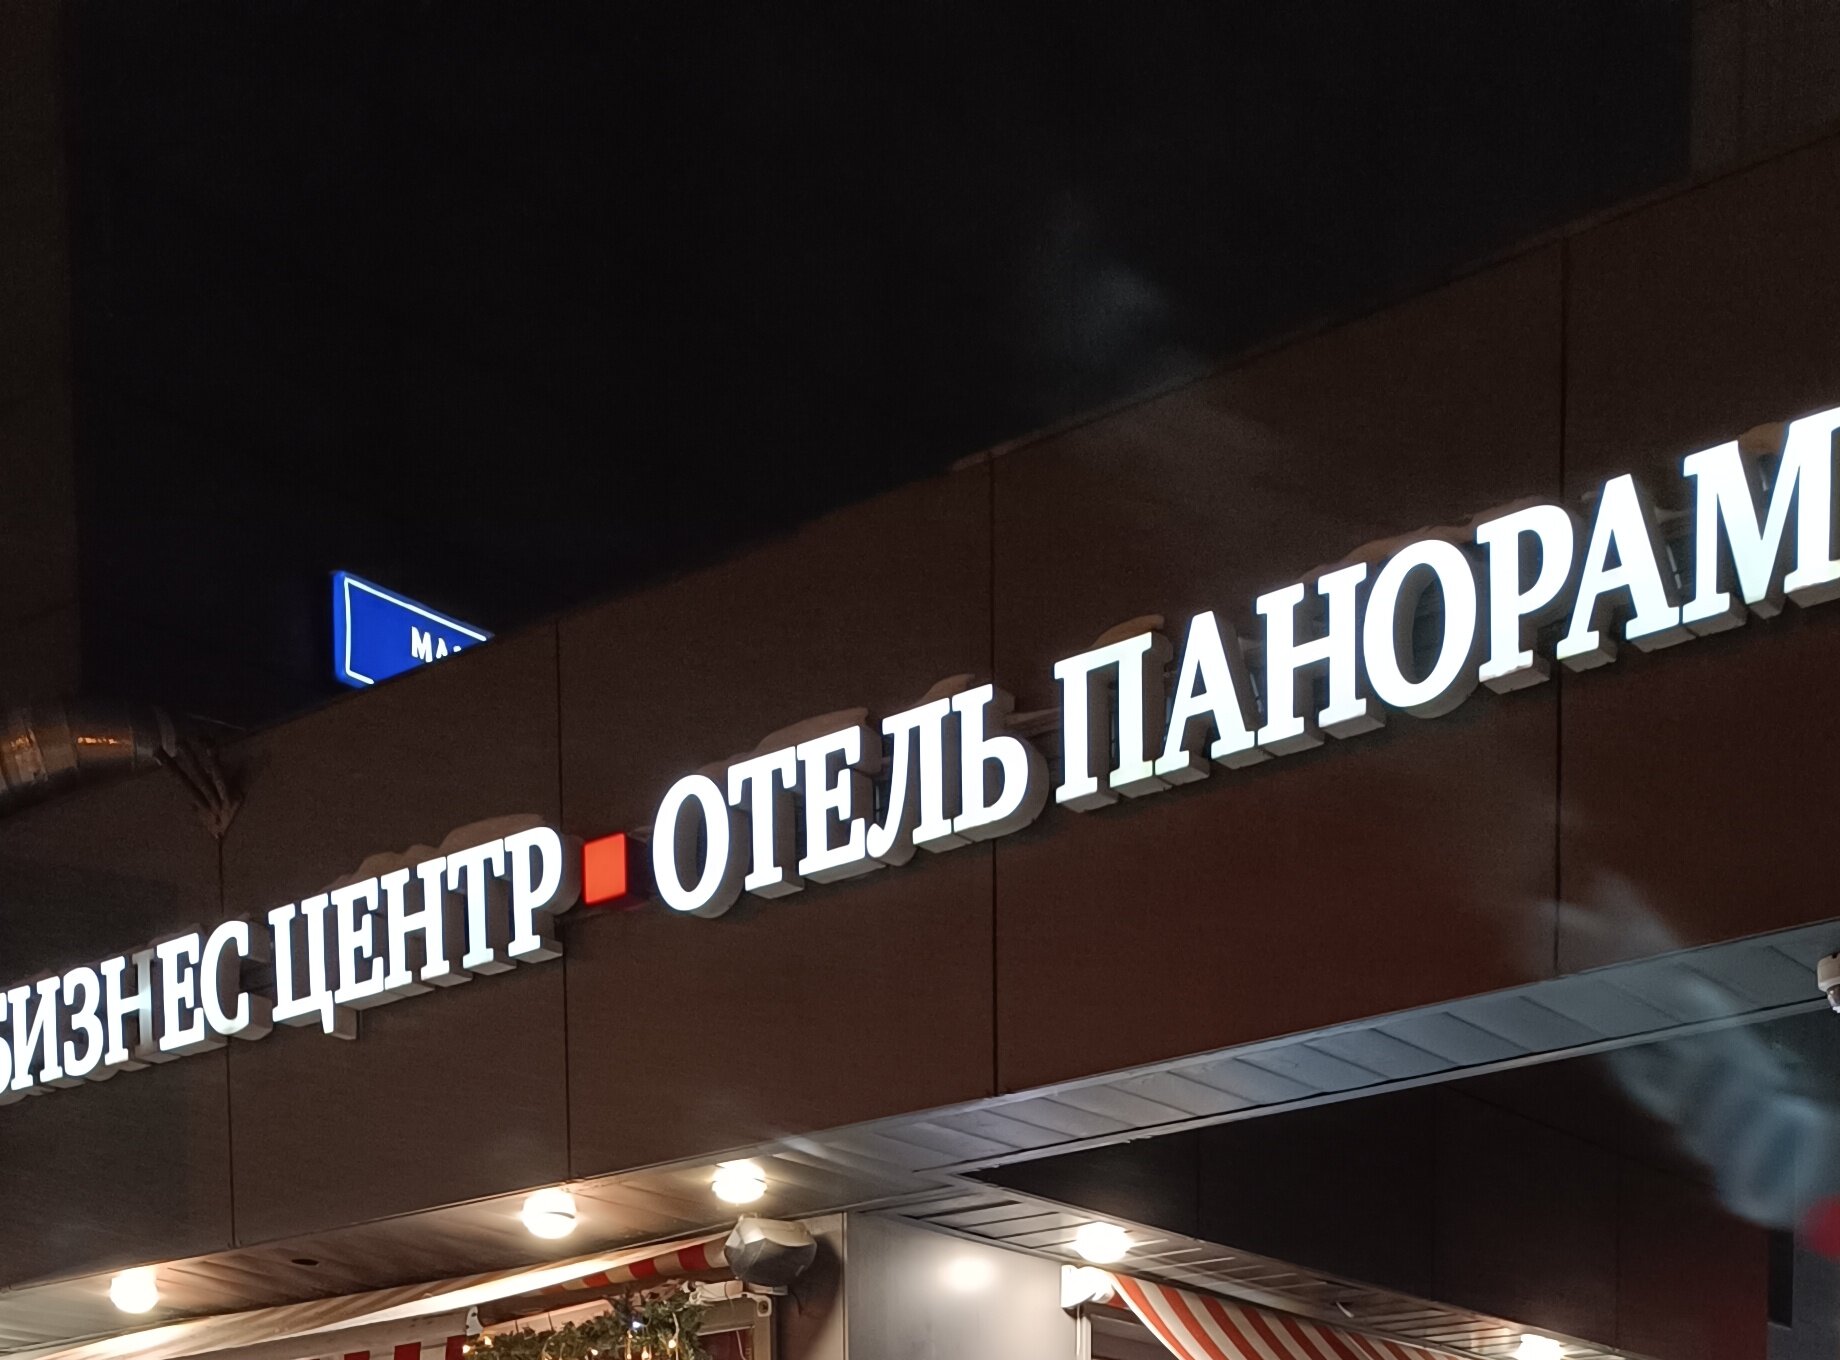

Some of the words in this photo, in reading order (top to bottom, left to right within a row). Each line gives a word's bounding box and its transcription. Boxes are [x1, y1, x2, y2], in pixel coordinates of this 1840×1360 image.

[268, 826, 562, 1034] ЦЕНТР
[652, 684, 1030, 911] ОТЕЛЬ
[1054, 406, 1840, 804] ПАНОРАМ
[411, 625, 462, 663] МА
